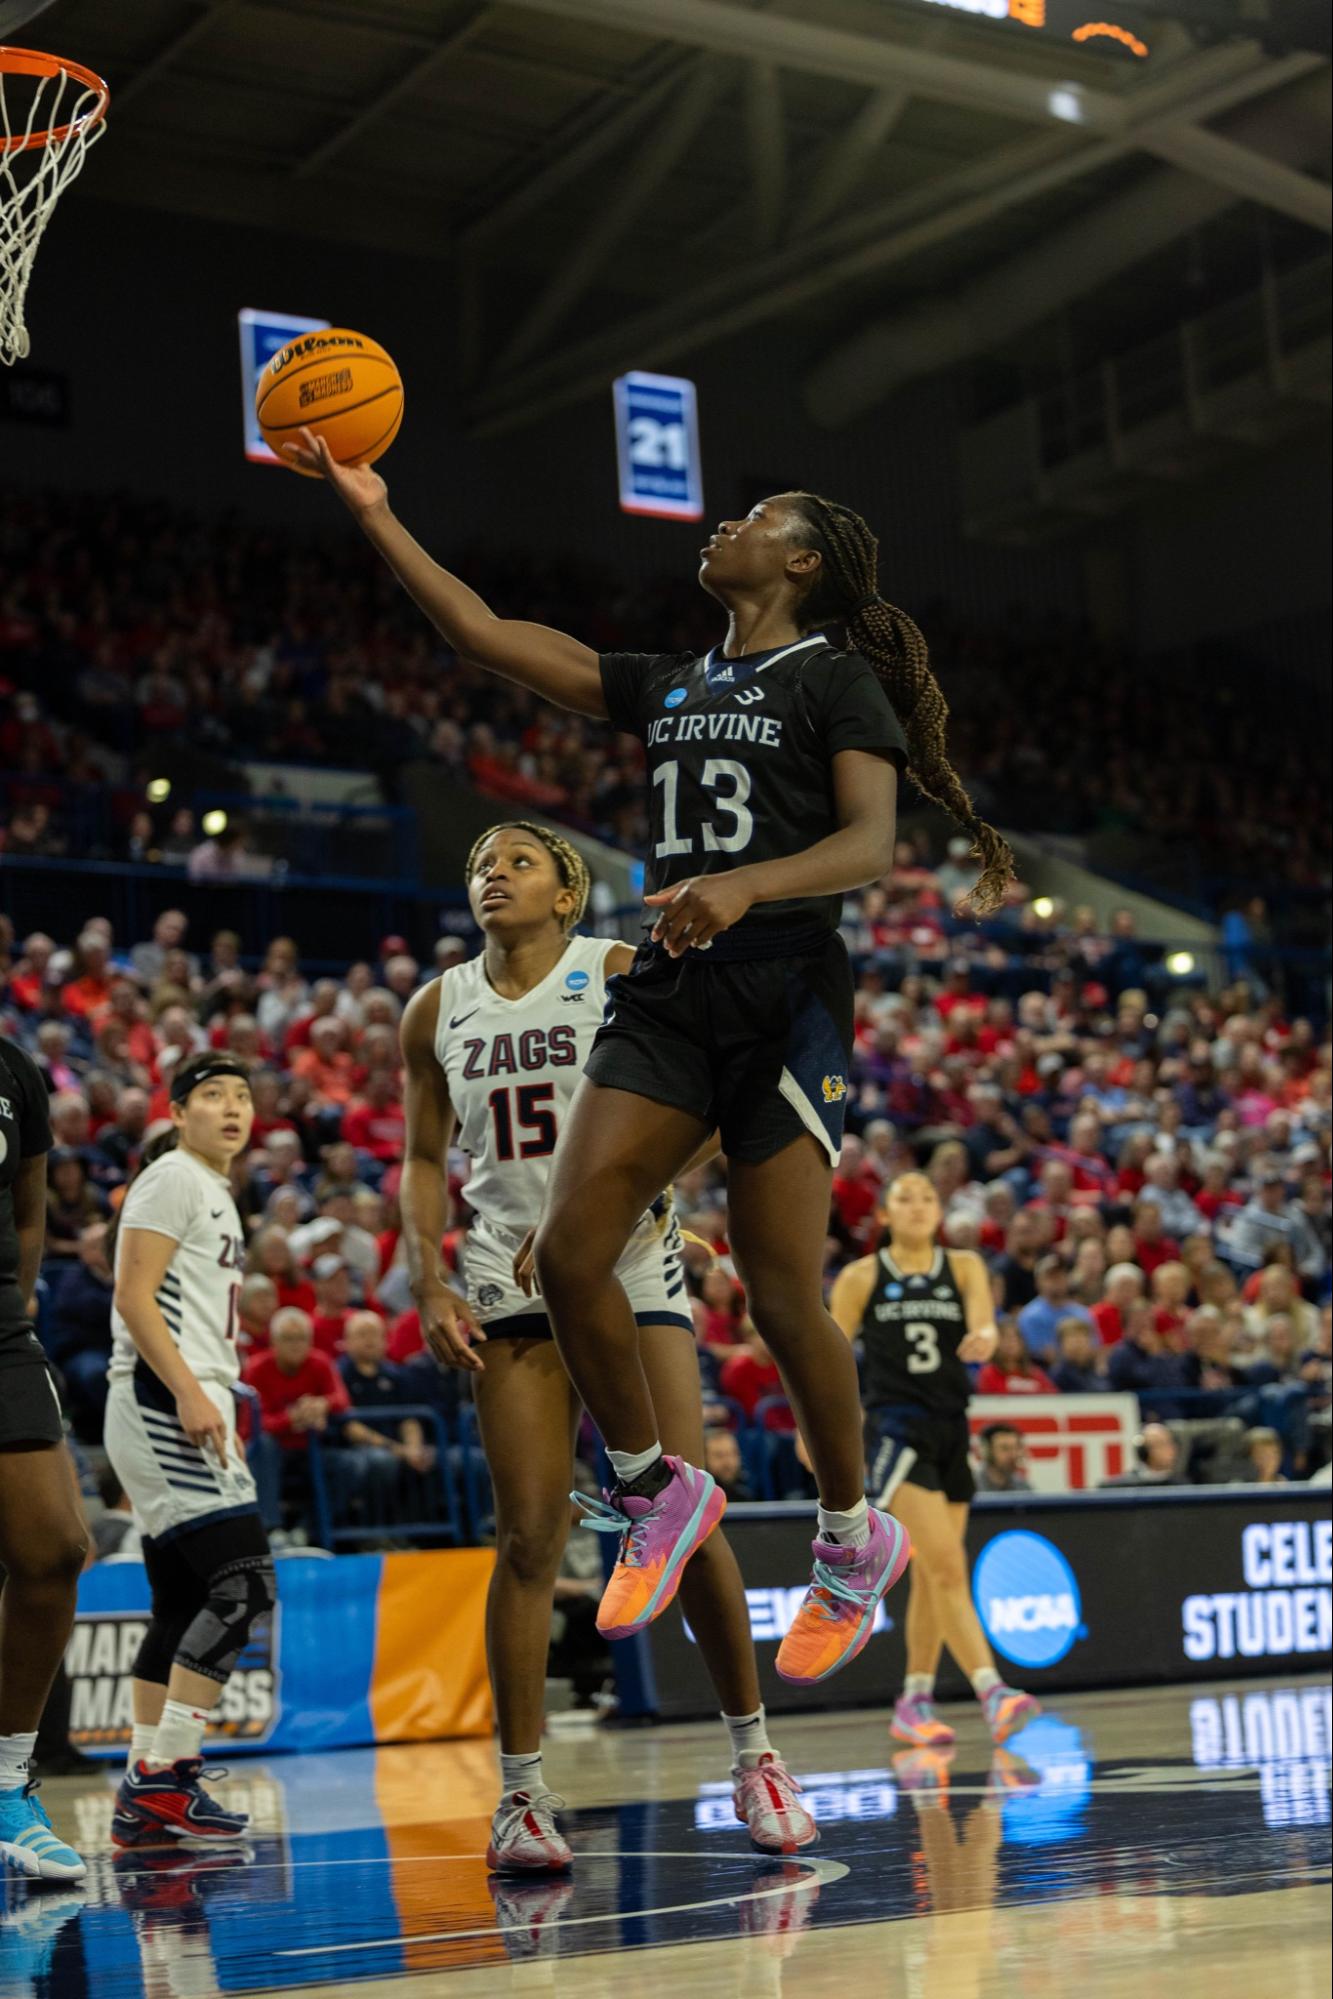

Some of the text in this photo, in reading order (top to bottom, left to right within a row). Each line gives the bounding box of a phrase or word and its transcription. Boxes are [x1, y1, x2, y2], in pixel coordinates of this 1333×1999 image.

[271, 337, 364, 375] Wilson
[628, 416, 688, 470] 21
[647, 714, 783, 748] UC IRVINE
[653, 759, 753, 859] 13
[462, 1025, 577, 1080] ZAGS
[488, 1082, 559, 1162] 15
[904, 1322, 942, 1374] 3
[989, 1593, 1079, 1634] NCAA
[65, 1621, 149, 1676] MAR
[69, 1669, 274, 1729] MASS
